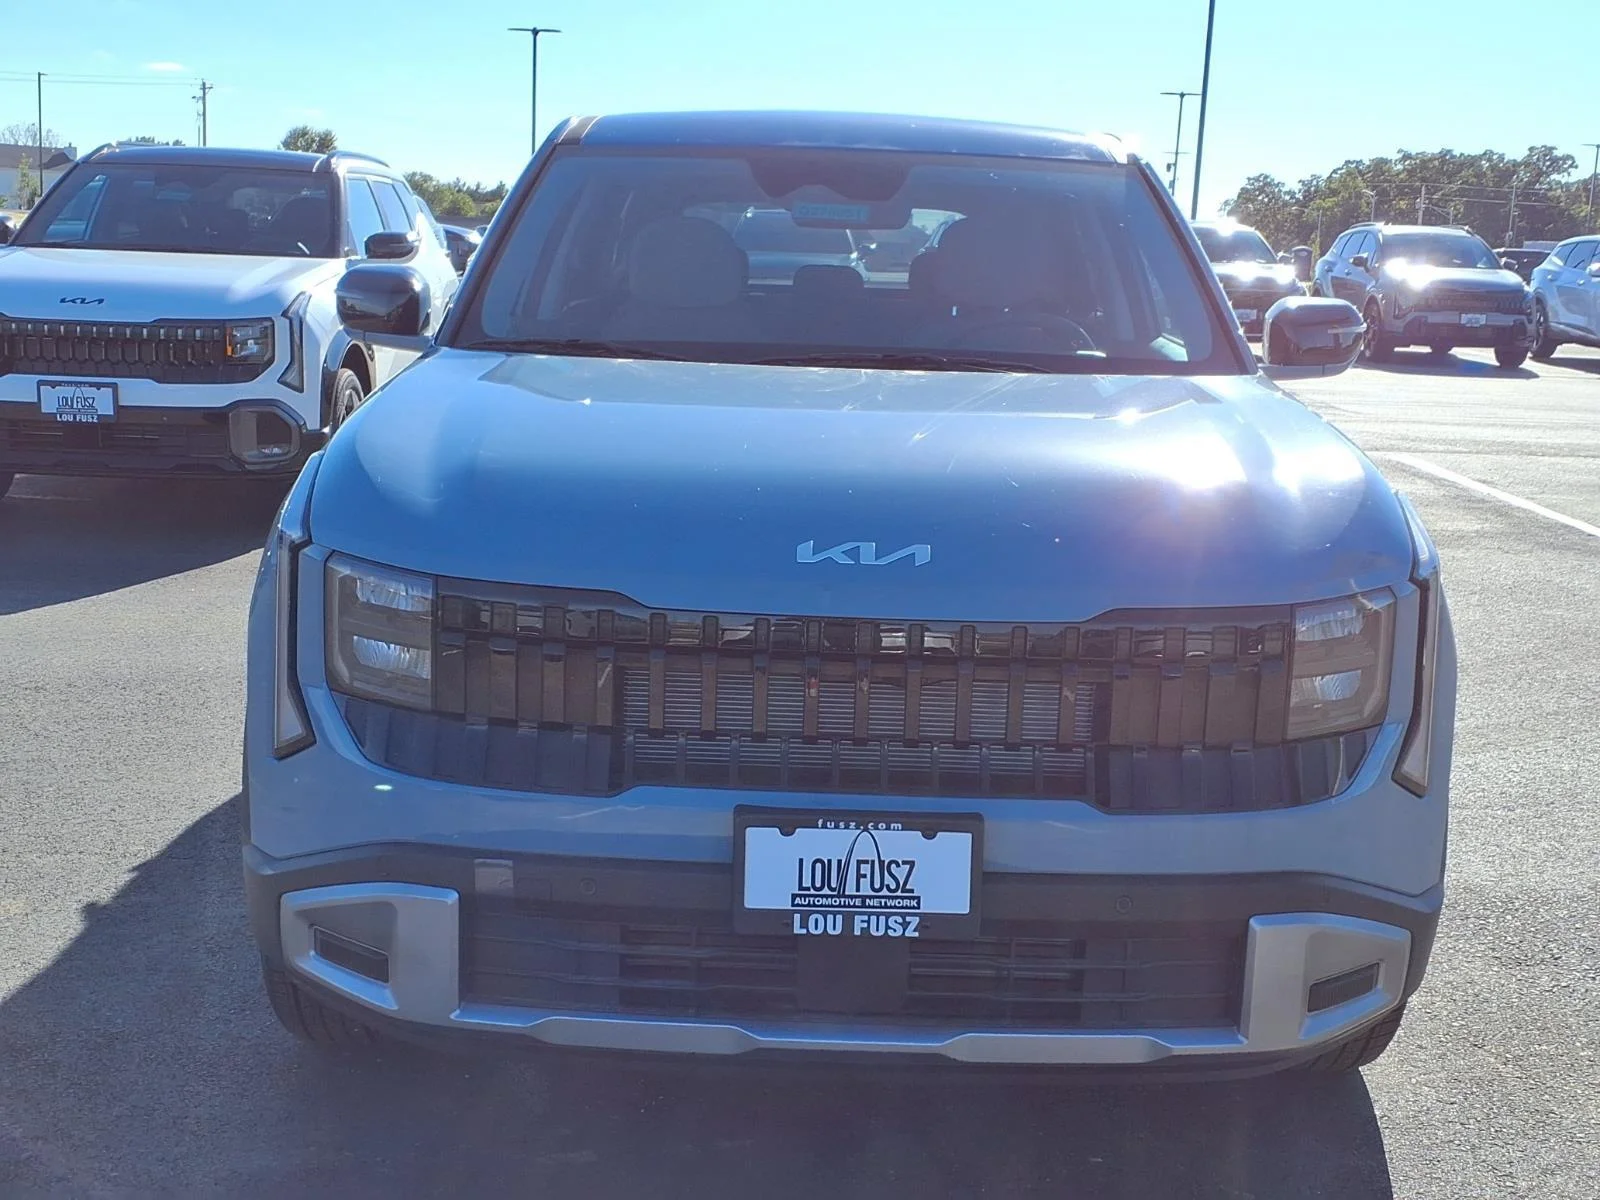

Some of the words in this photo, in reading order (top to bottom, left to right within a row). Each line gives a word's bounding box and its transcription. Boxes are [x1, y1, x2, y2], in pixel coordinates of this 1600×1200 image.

[57, 395, 73, 407] LOU
[76, 396, 96, 408] FUSZ
[56, 414, 73, 422] LOU
[76, 414, 98, 423] FUSZ
[817, 818, 902, 831] fusz.com
[798, 857, 842, 893] LOU
[855, 859, 916, 894] FUSZ
[794, 896, 862, 907] AUTOMOTIVE
[865, 898, 918, 908] NETWORK
[793, 913, 843, 935] LOU
[853, 914, 920, 937] FUSZ
